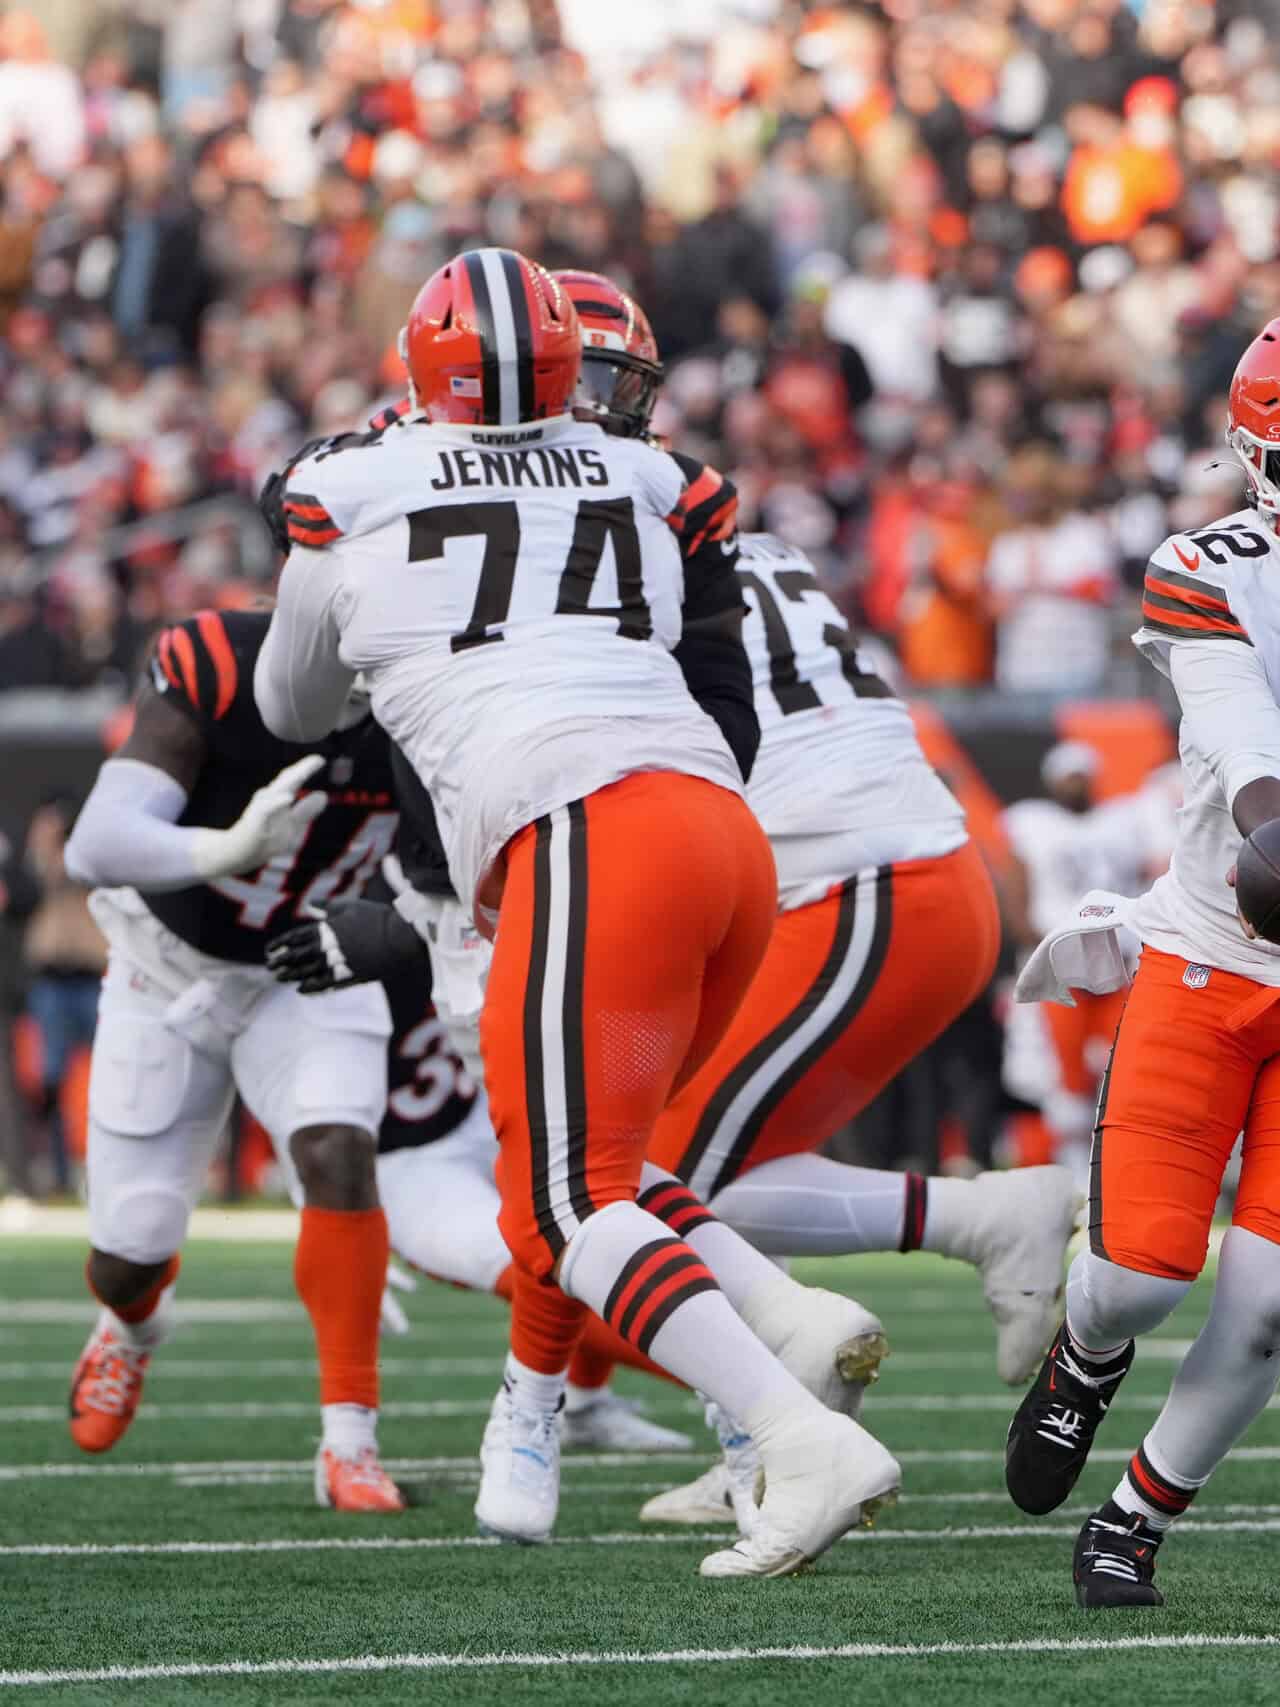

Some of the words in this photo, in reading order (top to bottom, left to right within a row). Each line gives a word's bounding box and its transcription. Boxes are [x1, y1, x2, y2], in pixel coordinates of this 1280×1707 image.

[430, 448, 609, 490] JENKINS
[406, 496, 653, 654] 74
[389, 1016, 479, 1122] 3
